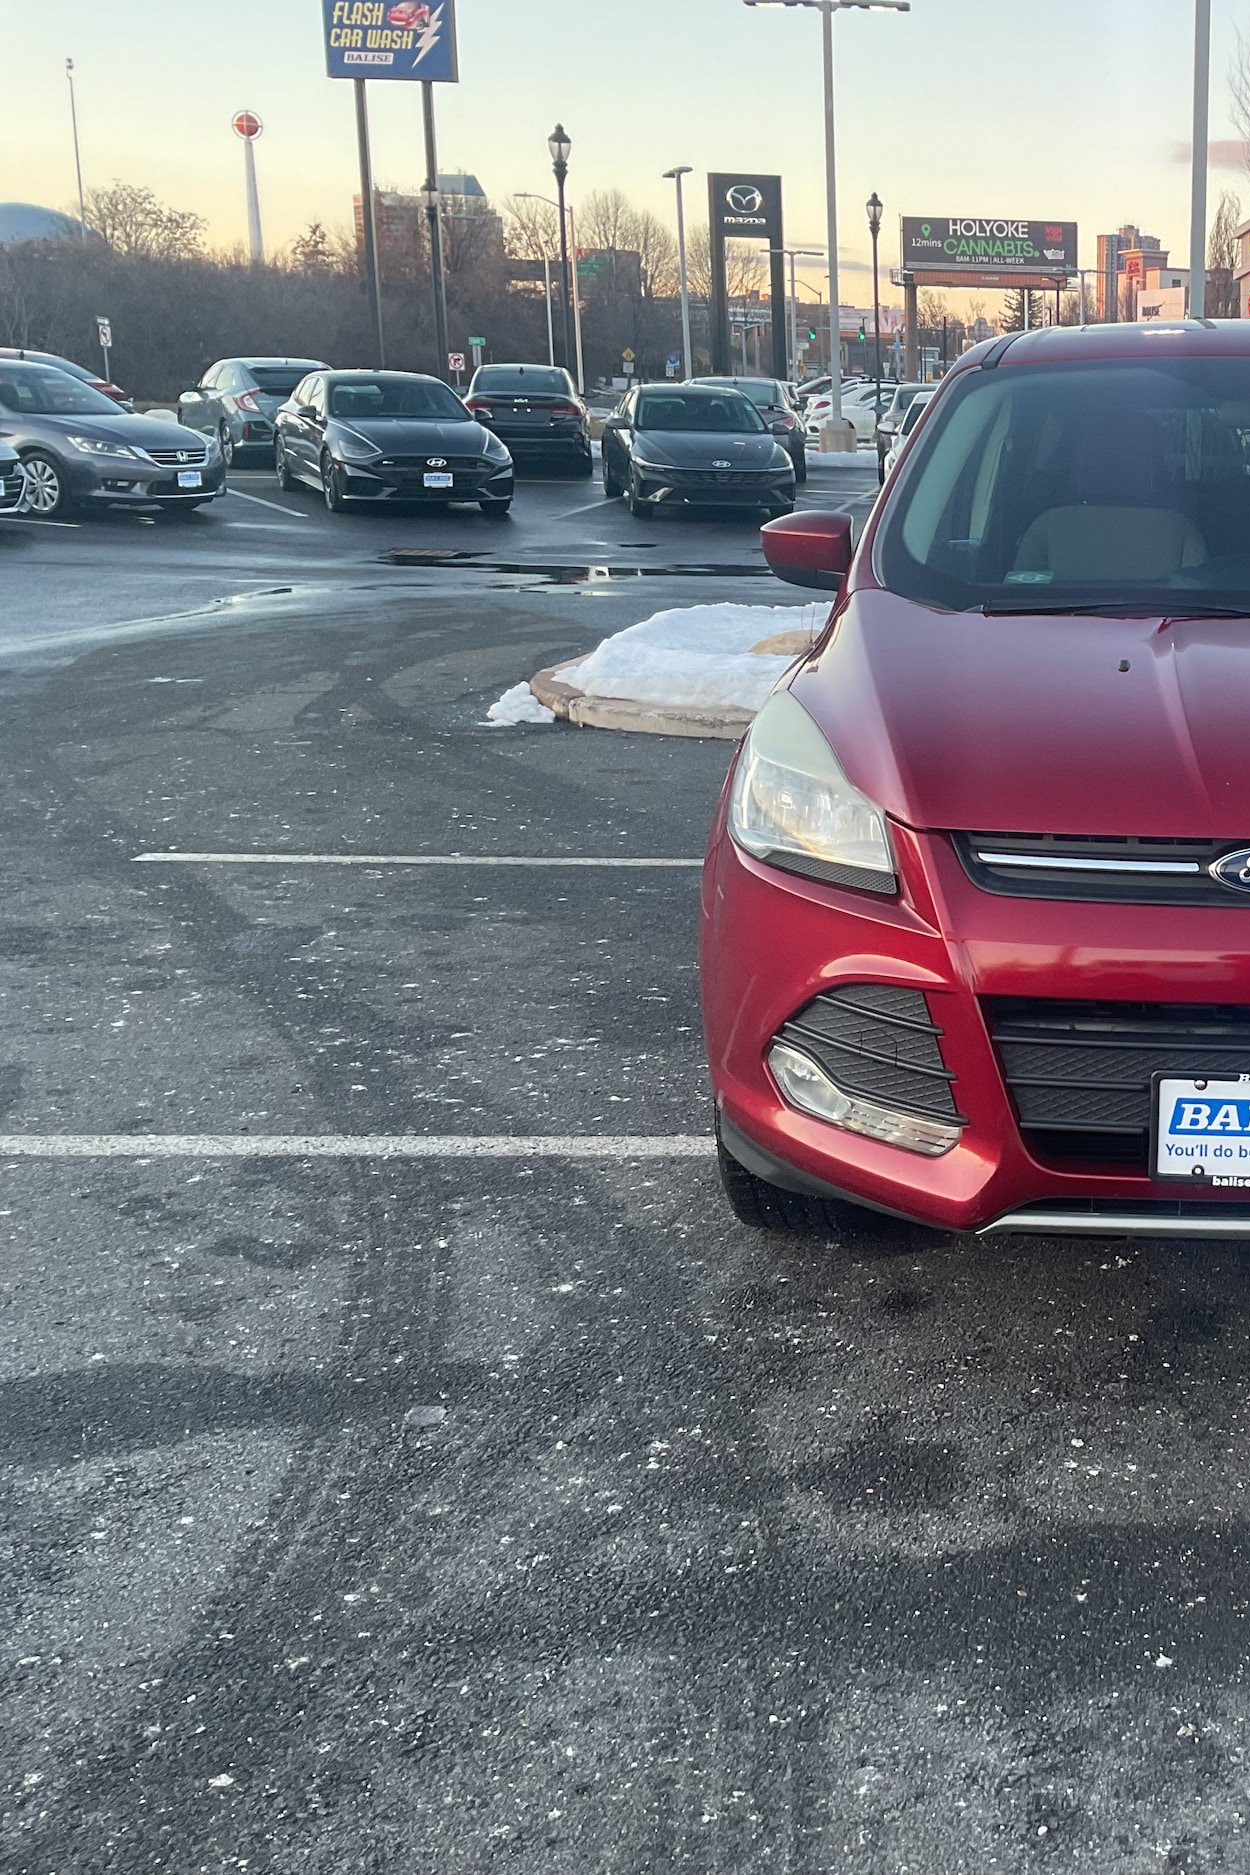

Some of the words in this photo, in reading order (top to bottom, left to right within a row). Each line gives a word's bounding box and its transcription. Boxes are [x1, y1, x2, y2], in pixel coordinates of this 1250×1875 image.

[333, 1, 384, 25] FLASH
[330, 28, 362, 48] CAR
[366, 29, 414, 49] WASH
[346, 53, 392, 63] BALISE
[948, 219, 1029, 238] HOLYOKE
[911, 238, 942, 248] 12mins
[1165, 1143, 1208, 1157] You'll
[1213, 1144, 1233, 1158] do
